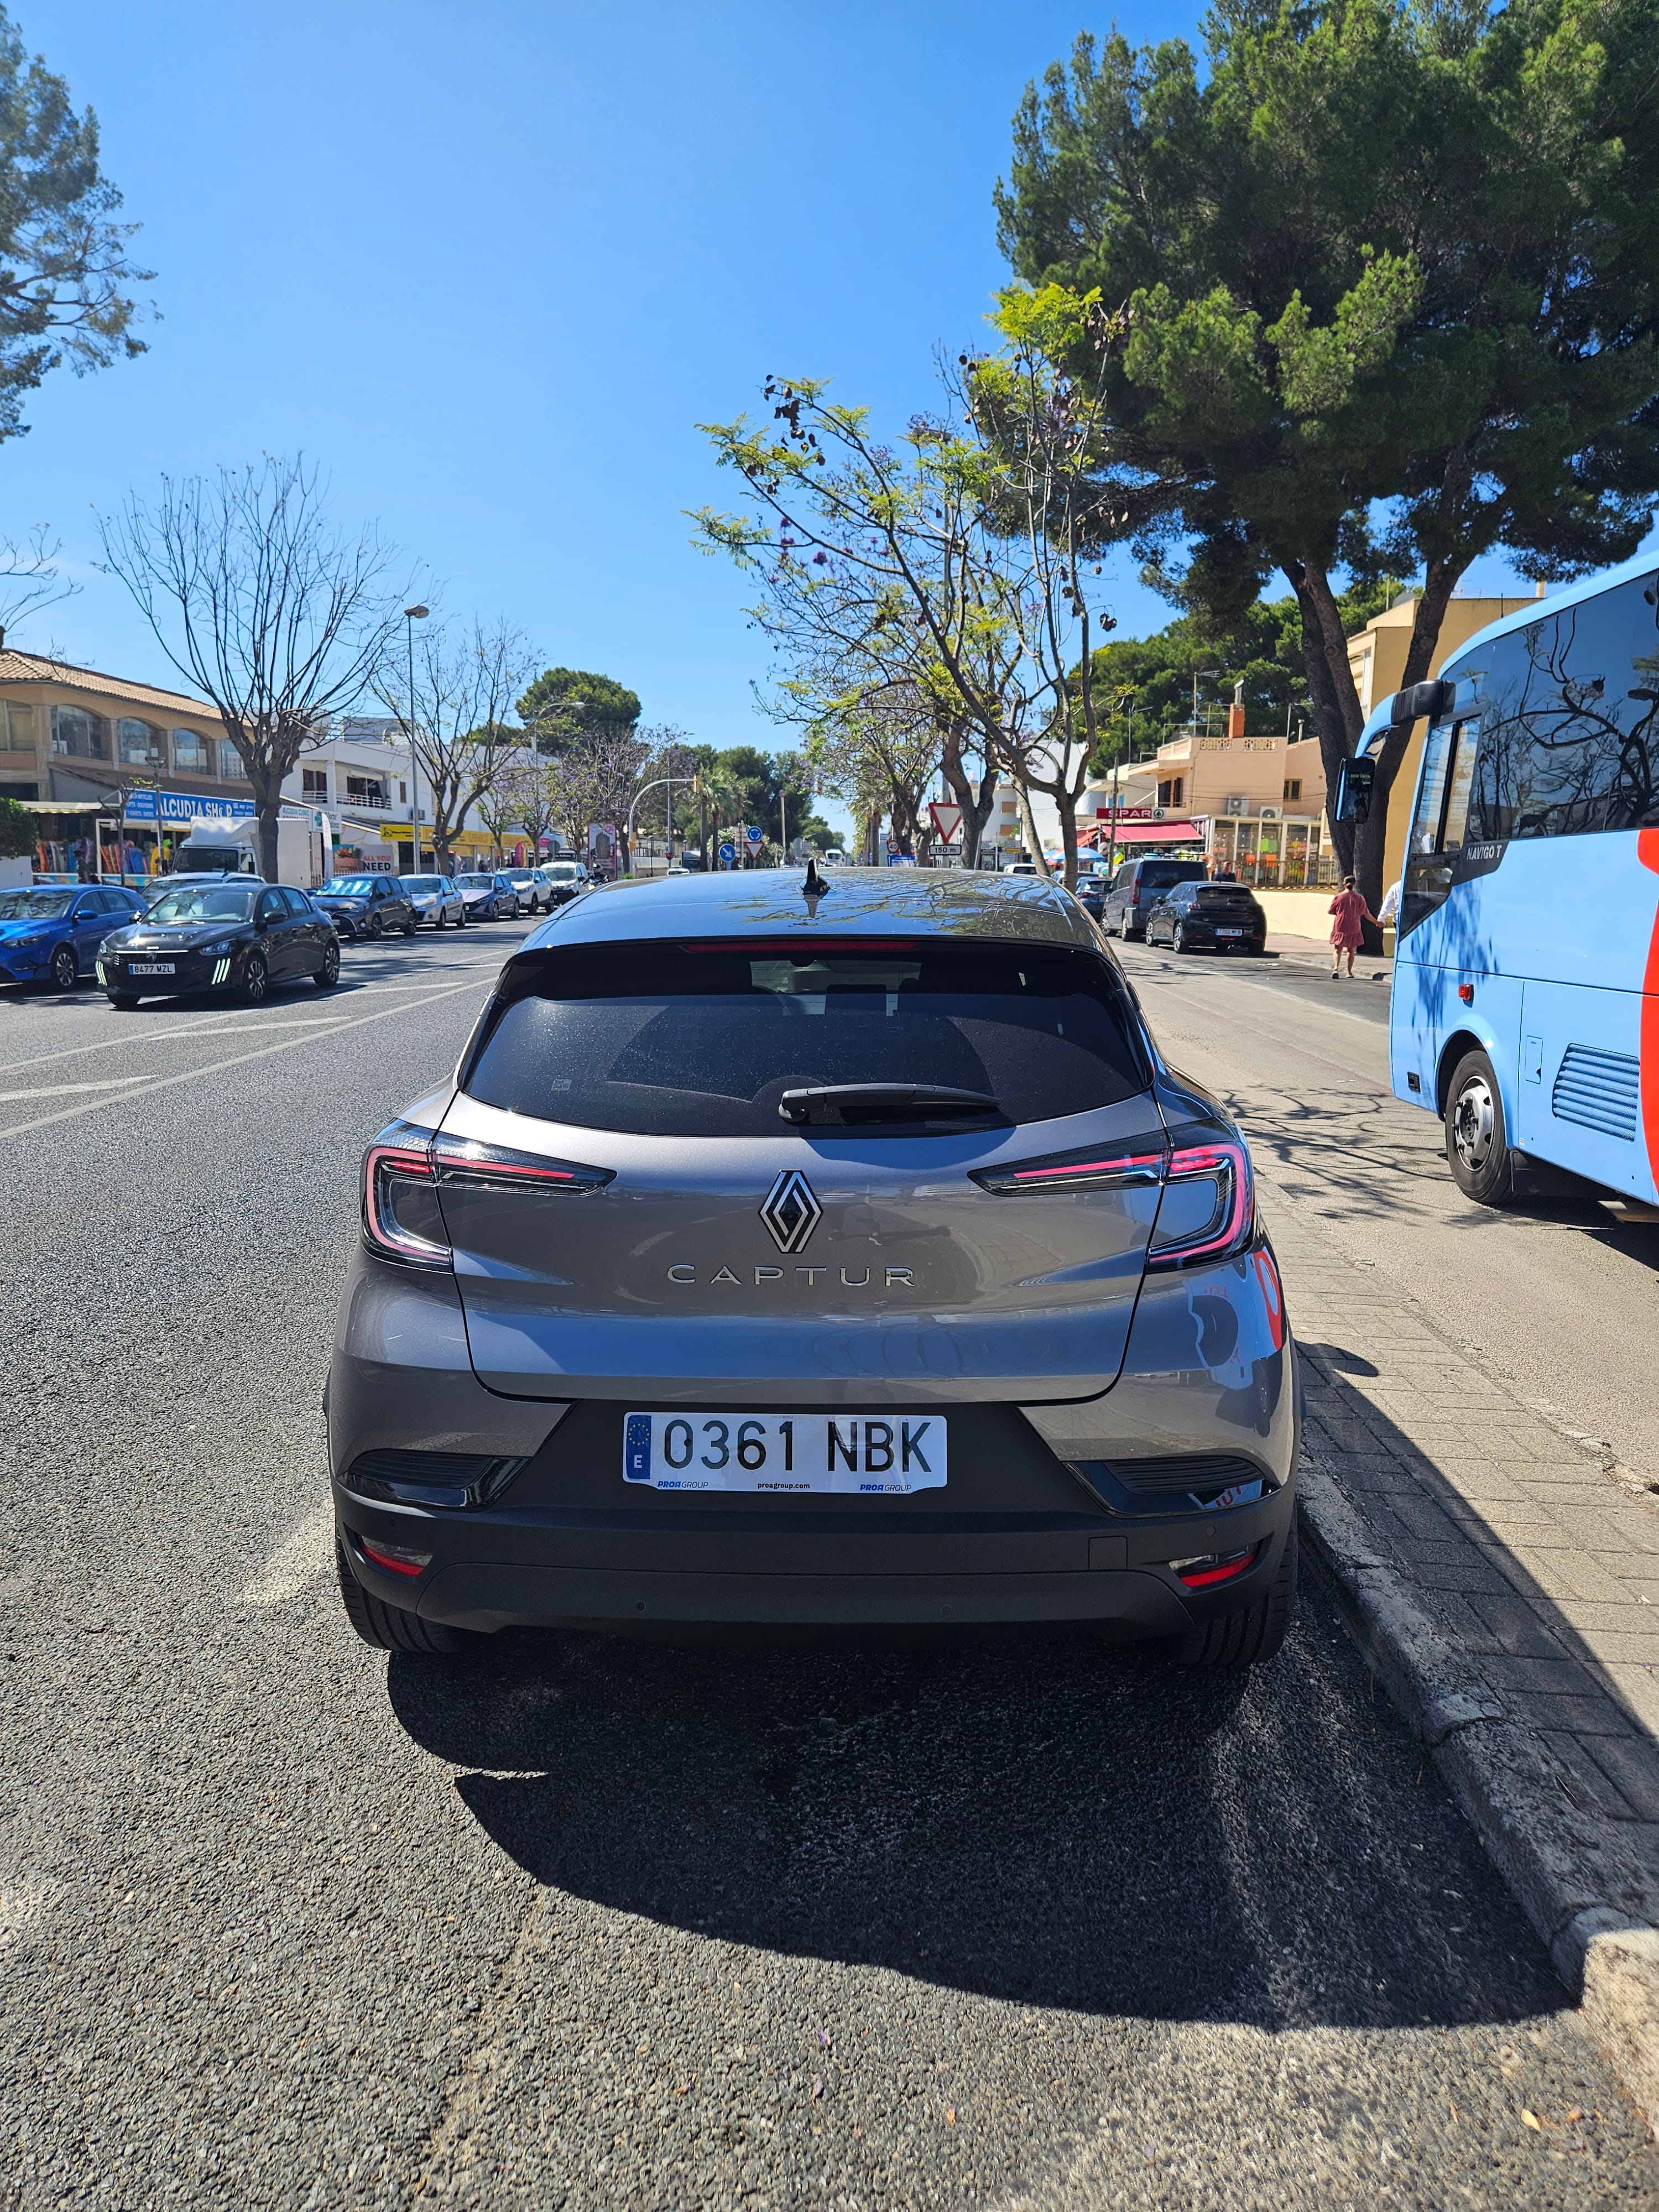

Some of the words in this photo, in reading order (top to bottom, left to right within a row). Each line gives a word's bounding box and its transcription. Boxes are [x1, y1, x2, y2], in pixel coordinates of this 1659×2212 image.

[156, 798, 204, 818] ALCUDIA
[1108, 810, 1151, 818] SPAR
[1467, 846, 1495, 860] NAVIGO
[1496, 845, 1503, 858] T
[363, 862, 391, 870] NEED
[156, 965, 173, 973] MZL
[667, 1264, 915, 1287] CAPTUR
[665, 1420, 792, 1471] 0361
[828, 1421, 932, 1473] NBK
[634, 1455, 643, 1469] E
